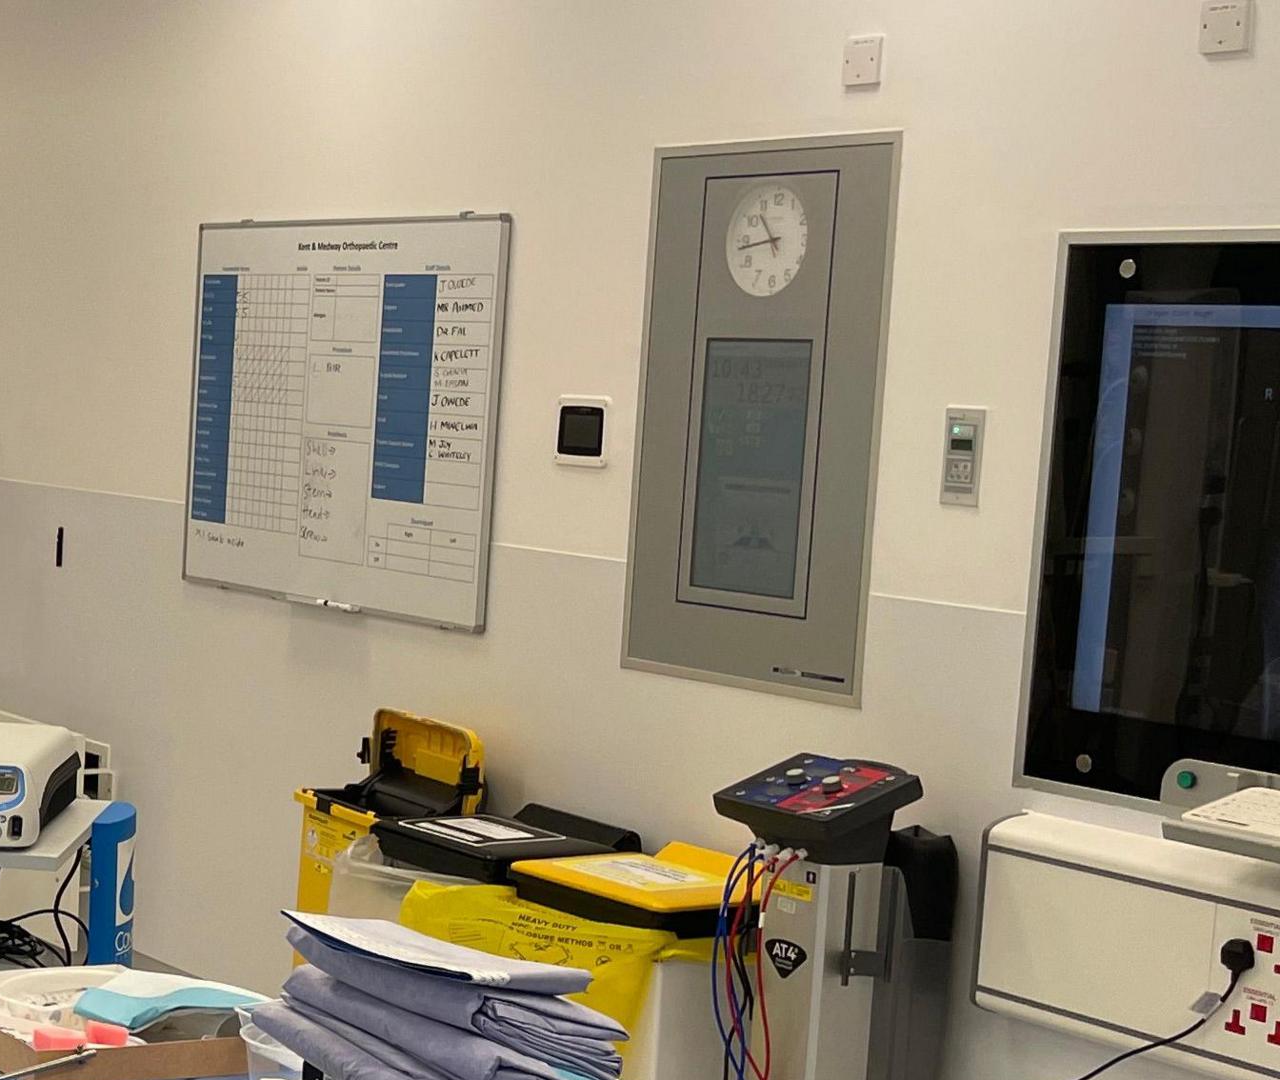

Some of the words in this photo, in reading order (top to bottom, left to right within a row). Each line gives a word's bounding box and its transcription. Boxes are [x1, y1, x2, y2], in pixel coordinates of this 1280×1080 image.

[298, 243, 310, 251] Kent
[312, 243, 316, 251] &
[318, 242, 341, 252] Medway
[343, 241, 377, 252] Orthopaedic
[379, 241, 398, 250] Centre
[1264, 387, 1274, 402] R
[518, 913, 550, 927] HEAVY
[552, 921, 578, 932] DUTY
[557, 936, 593, 948] METHOD
